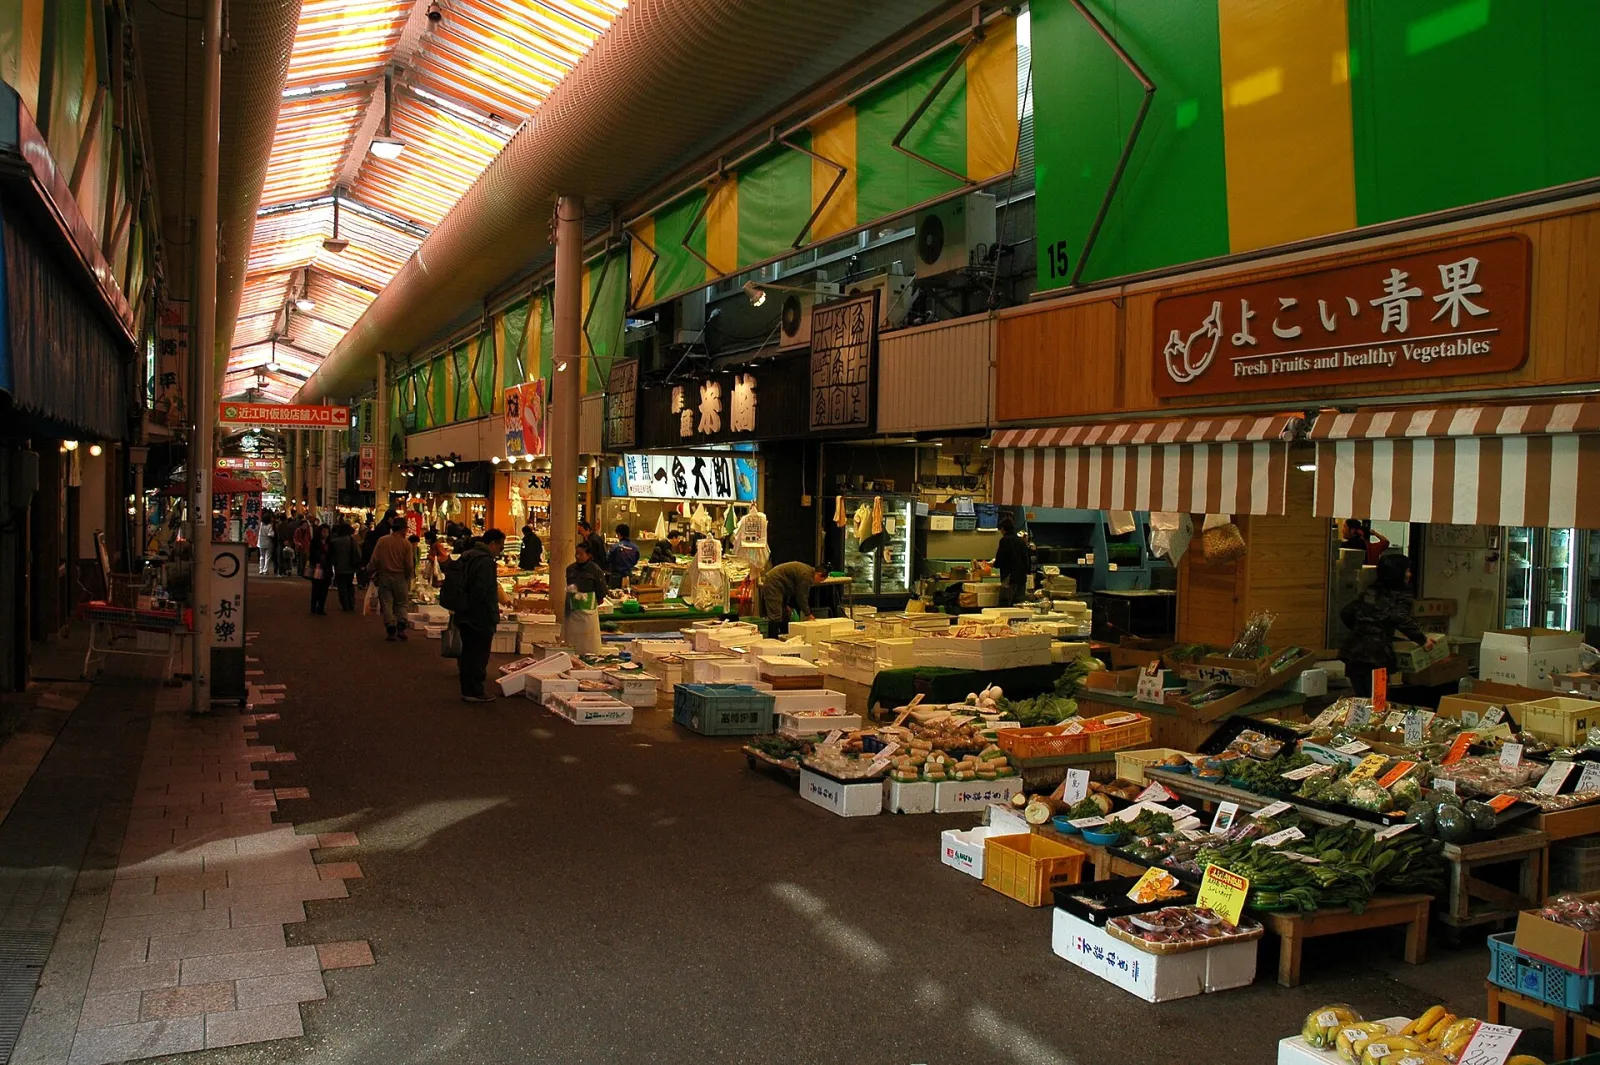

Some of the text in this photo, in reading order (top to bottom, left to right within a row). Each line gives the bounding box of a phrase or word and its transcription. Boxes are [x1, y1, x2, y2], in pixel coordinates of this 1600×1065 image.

[1047, 241, 1069, 280] 15
[1231, 256, 1490, 346] よこい青果
[1233, 338, 1490, 377] Fresh Fruits and healthy Vegetables
[238, 407, 330, 421] 近江町仮設店舗入口
[1082, 938, 1129, 972] 万能ねぎ
